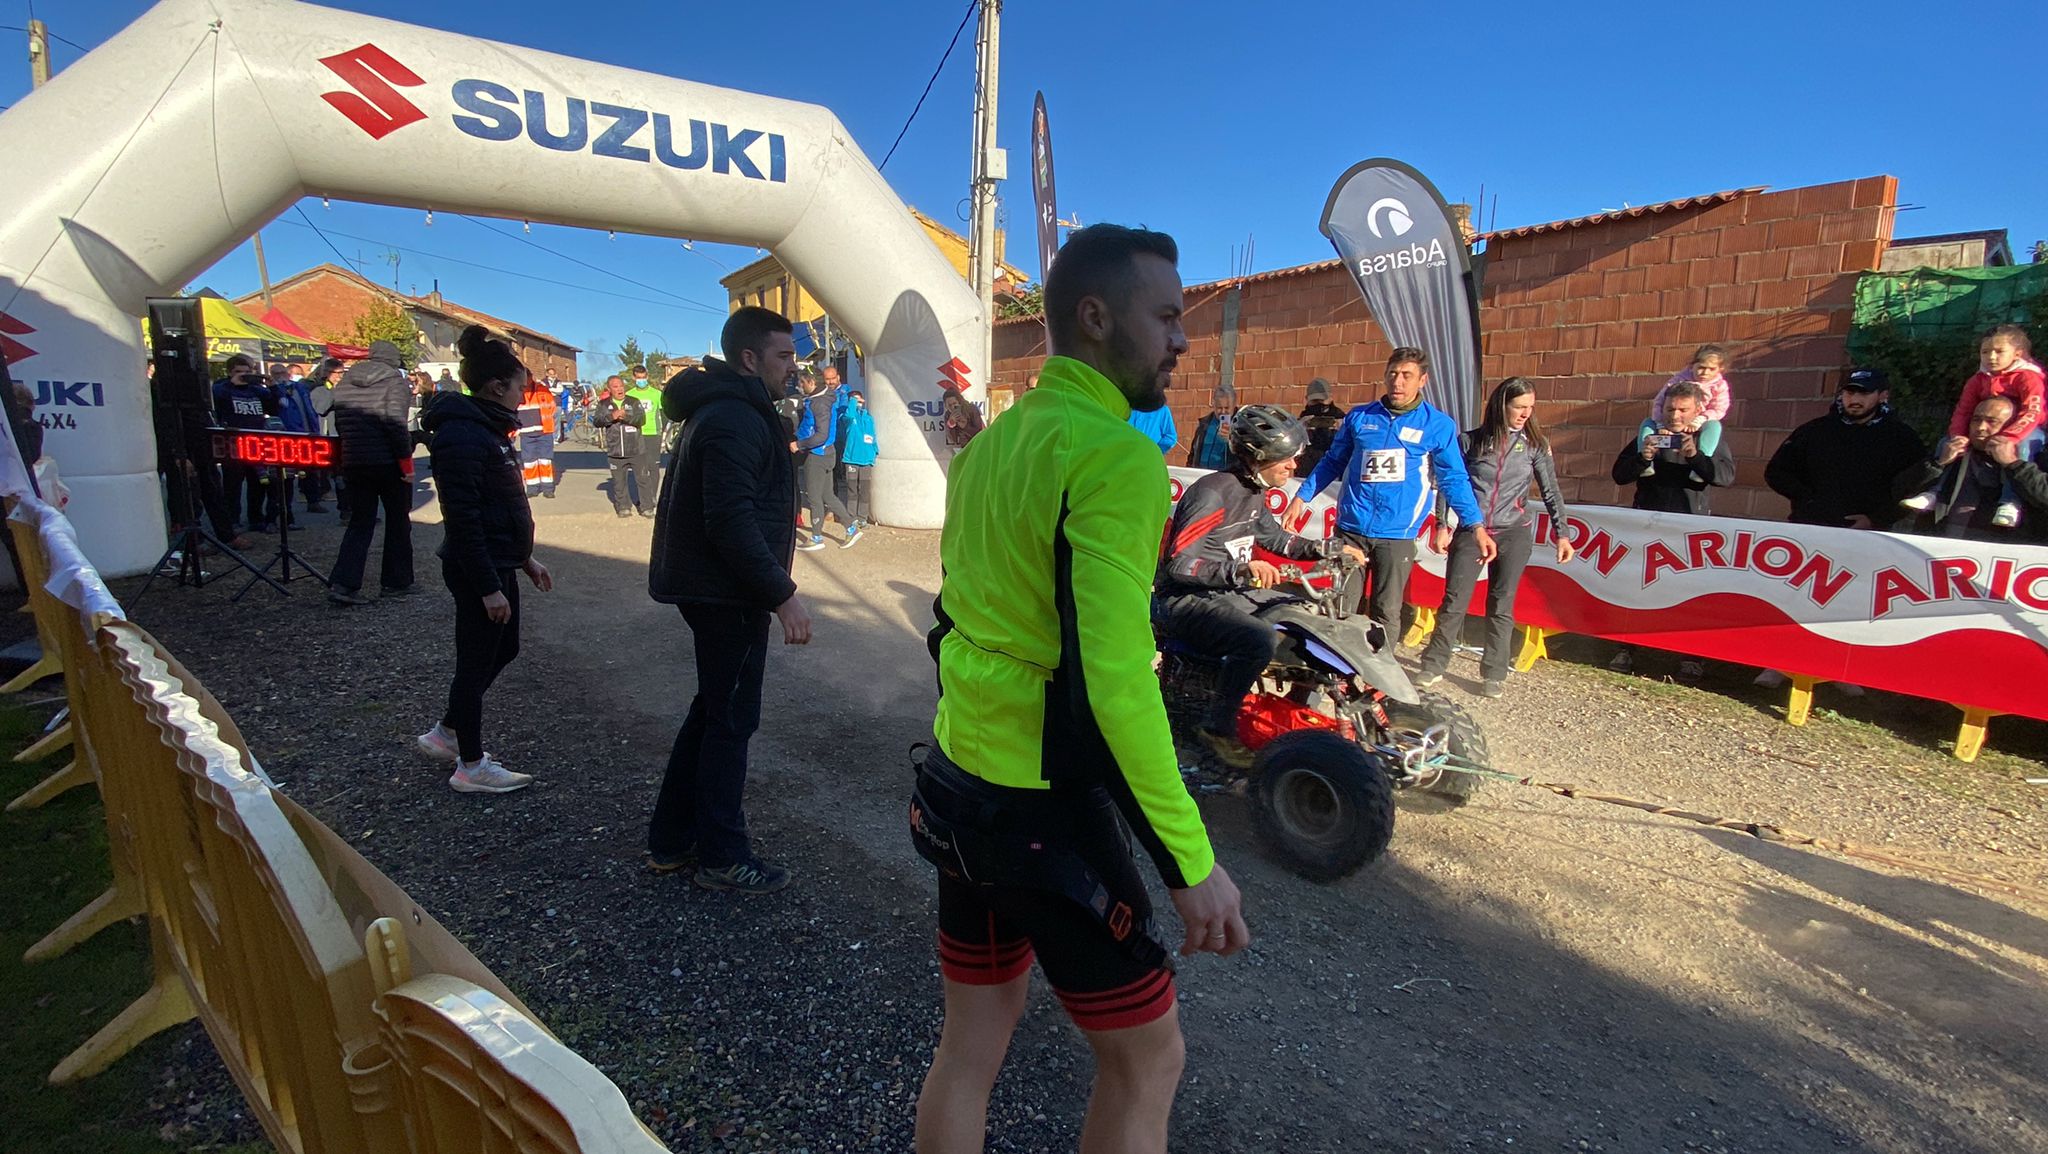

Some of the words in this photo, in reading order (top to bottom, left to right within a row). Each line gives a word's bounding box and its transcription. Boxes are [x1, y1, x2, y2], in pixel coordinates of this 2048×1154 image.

[451, 79, 787, 183] SUZUKI
[10, 380, 104, 407] UKI
[1366, 456, 1397, 474] 44
[1534, 512, 1630, 577] ION
[1643, 531, 1856, 608] ARION
[1871, 557, 2048, 621] ARIO
